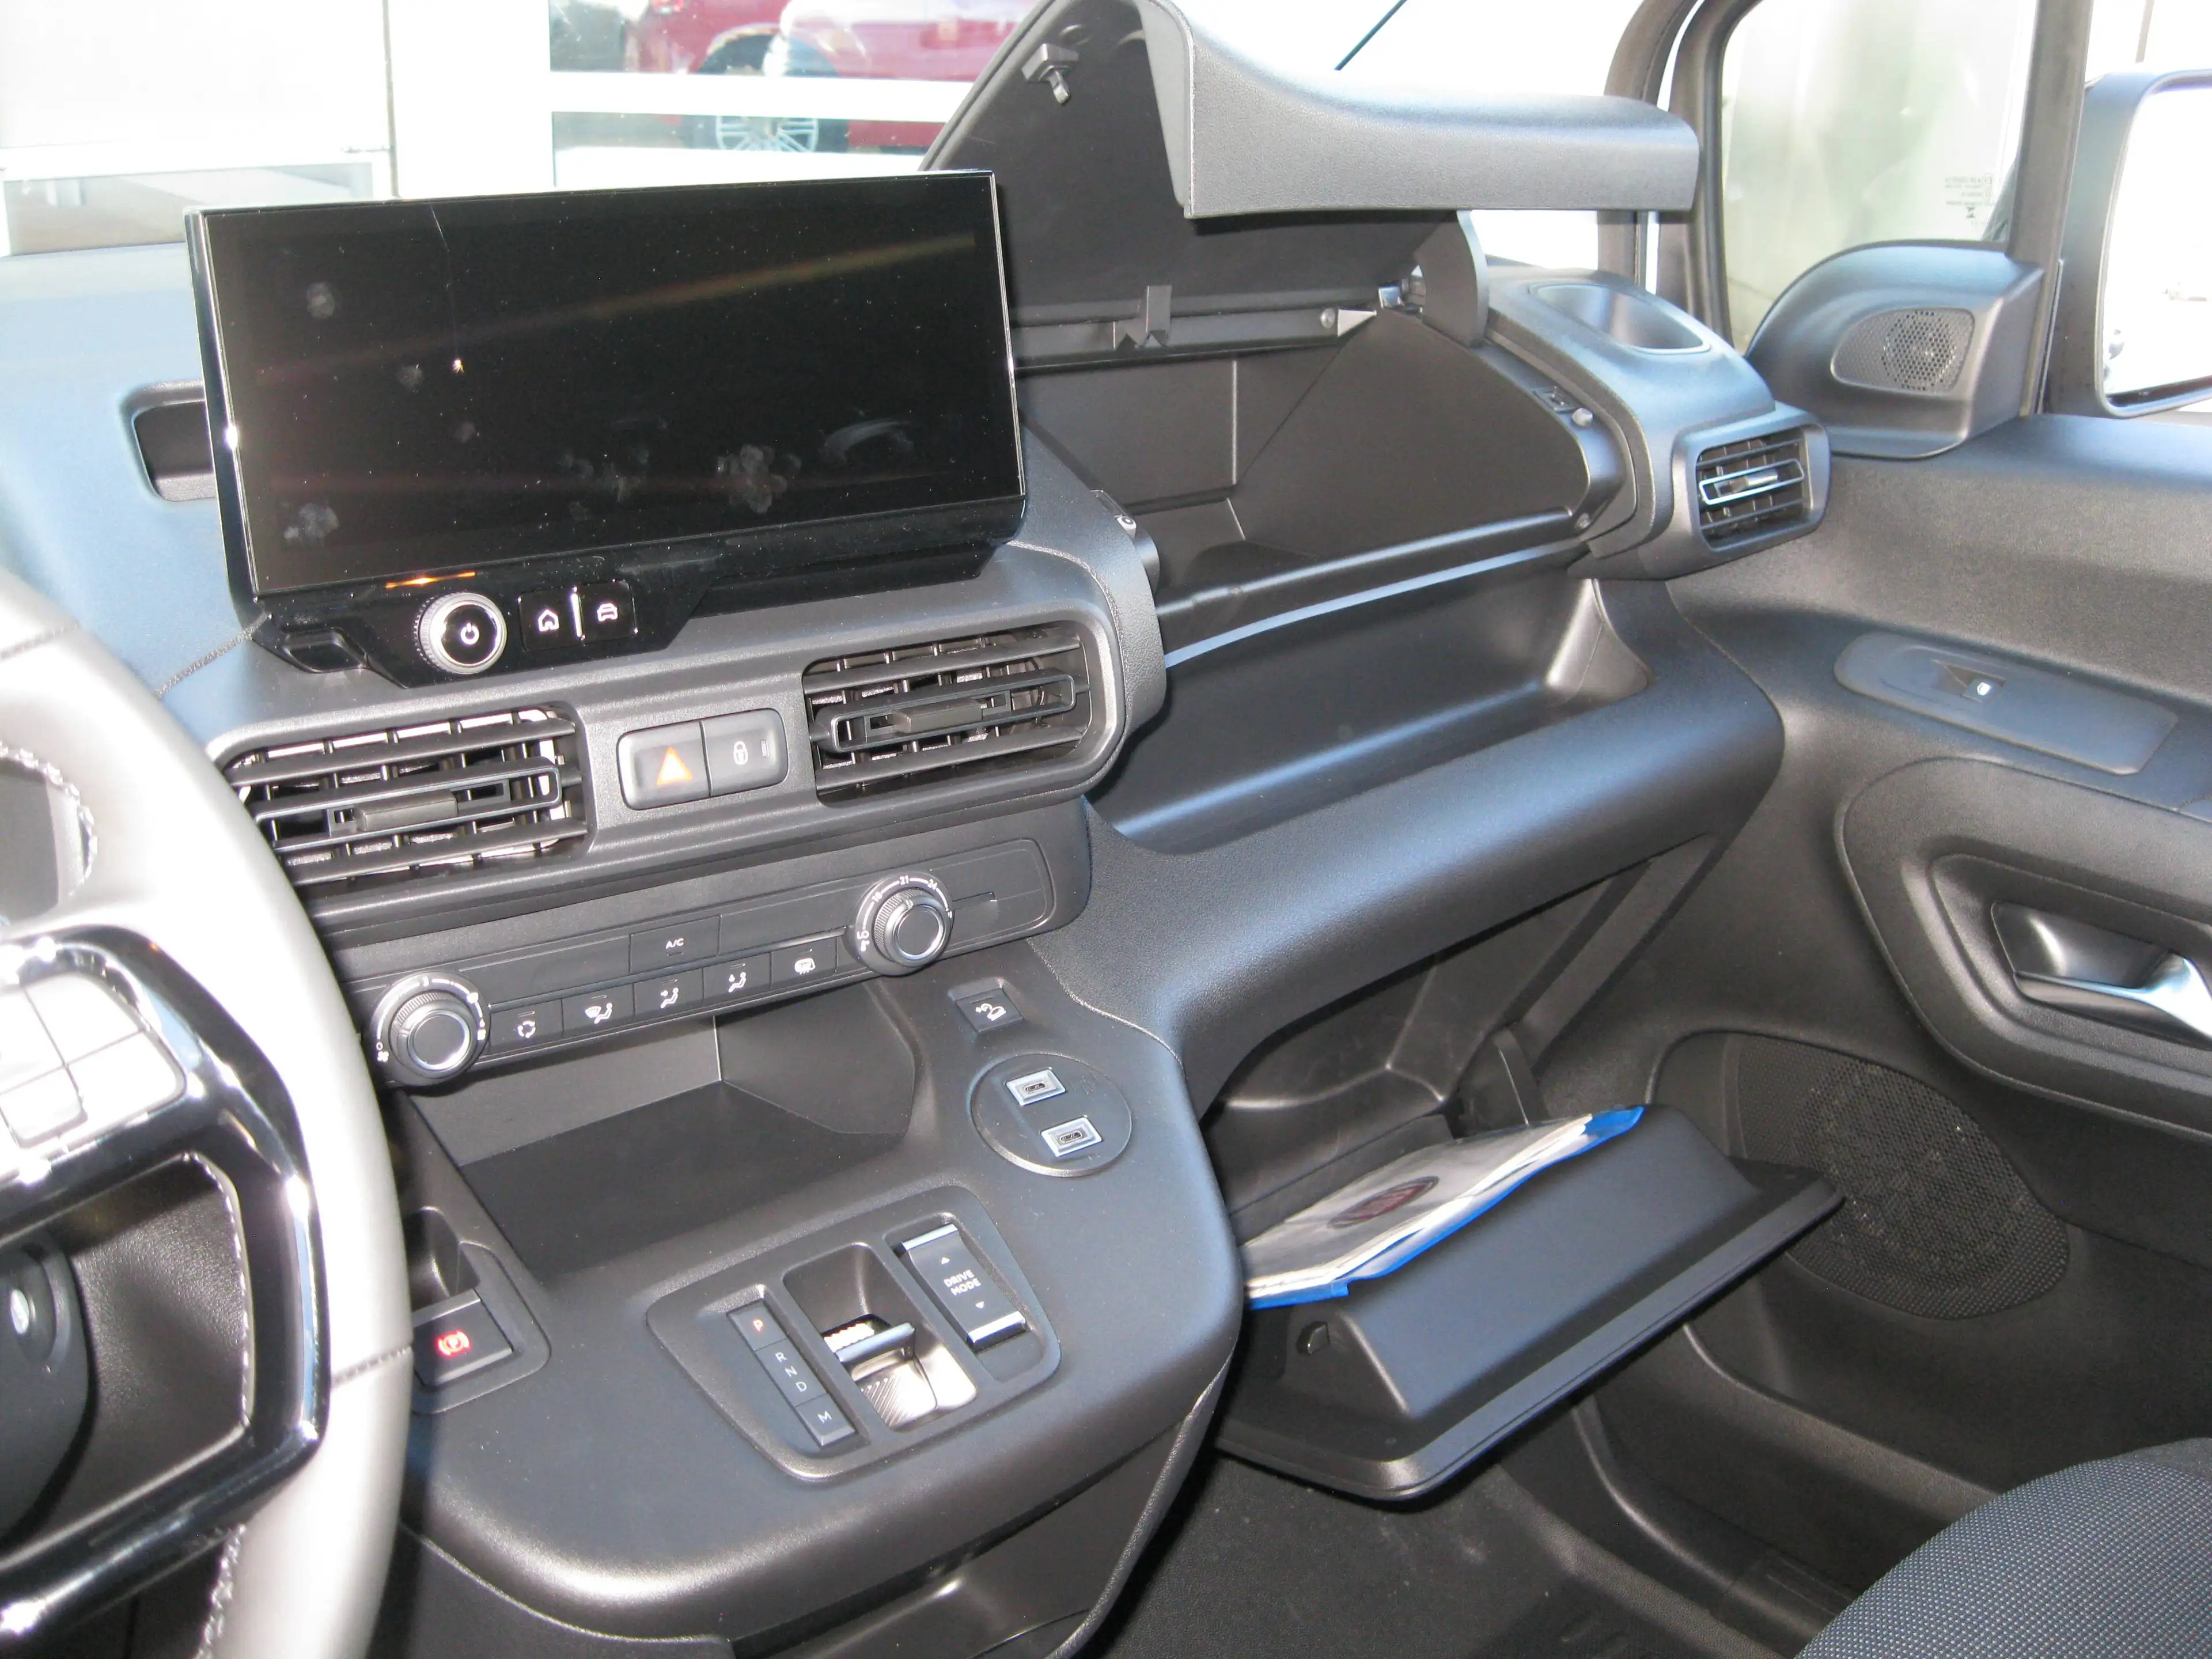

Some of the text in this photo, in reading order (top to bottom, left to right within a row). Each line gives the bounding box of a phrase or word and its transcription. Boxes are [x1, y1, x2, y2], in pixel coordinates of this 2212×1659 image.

[665, 938, 684, 949] A/C
[944, 1269, 975, 1287] DRIVE
[950, 1278, 982, 1296] MODE
[753, 1319, 763, 1331] P
[775, 1352, 787, 1363] R
[785, 1366, 797, 1377] N
[796, 1381, 807, 1392] D
[817, 1411, 832, 1423] M
